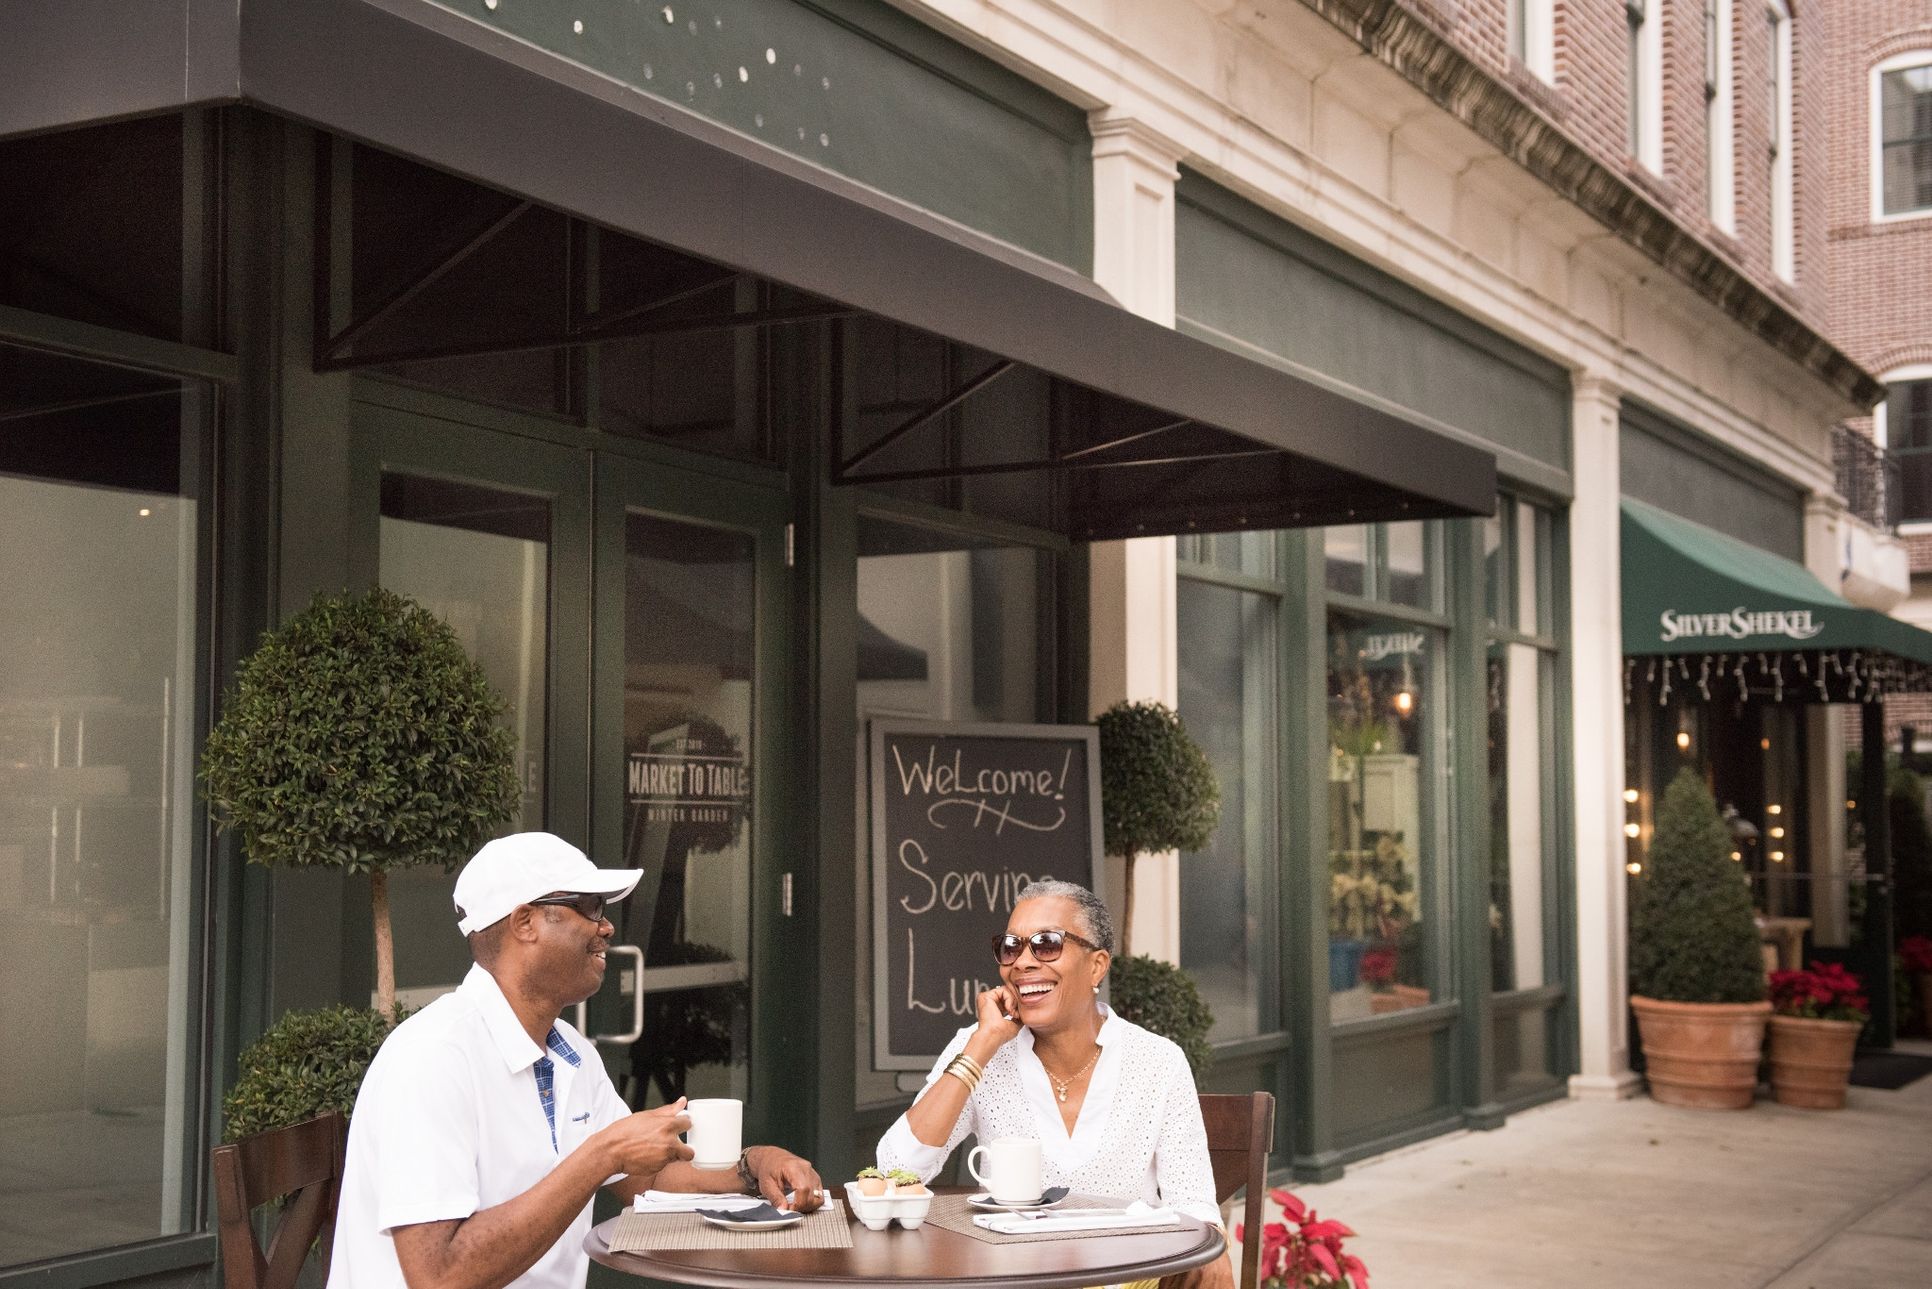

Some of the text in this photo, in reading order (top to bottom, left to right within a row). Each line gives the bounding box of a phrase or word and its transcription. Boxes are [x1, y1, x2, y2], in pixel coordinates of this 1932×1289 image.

[629, 761, 748, 796] MARKET TO TABLE
[900, 839, 1056, 914] Servin
[907, 927, 991, 1020] Lun
